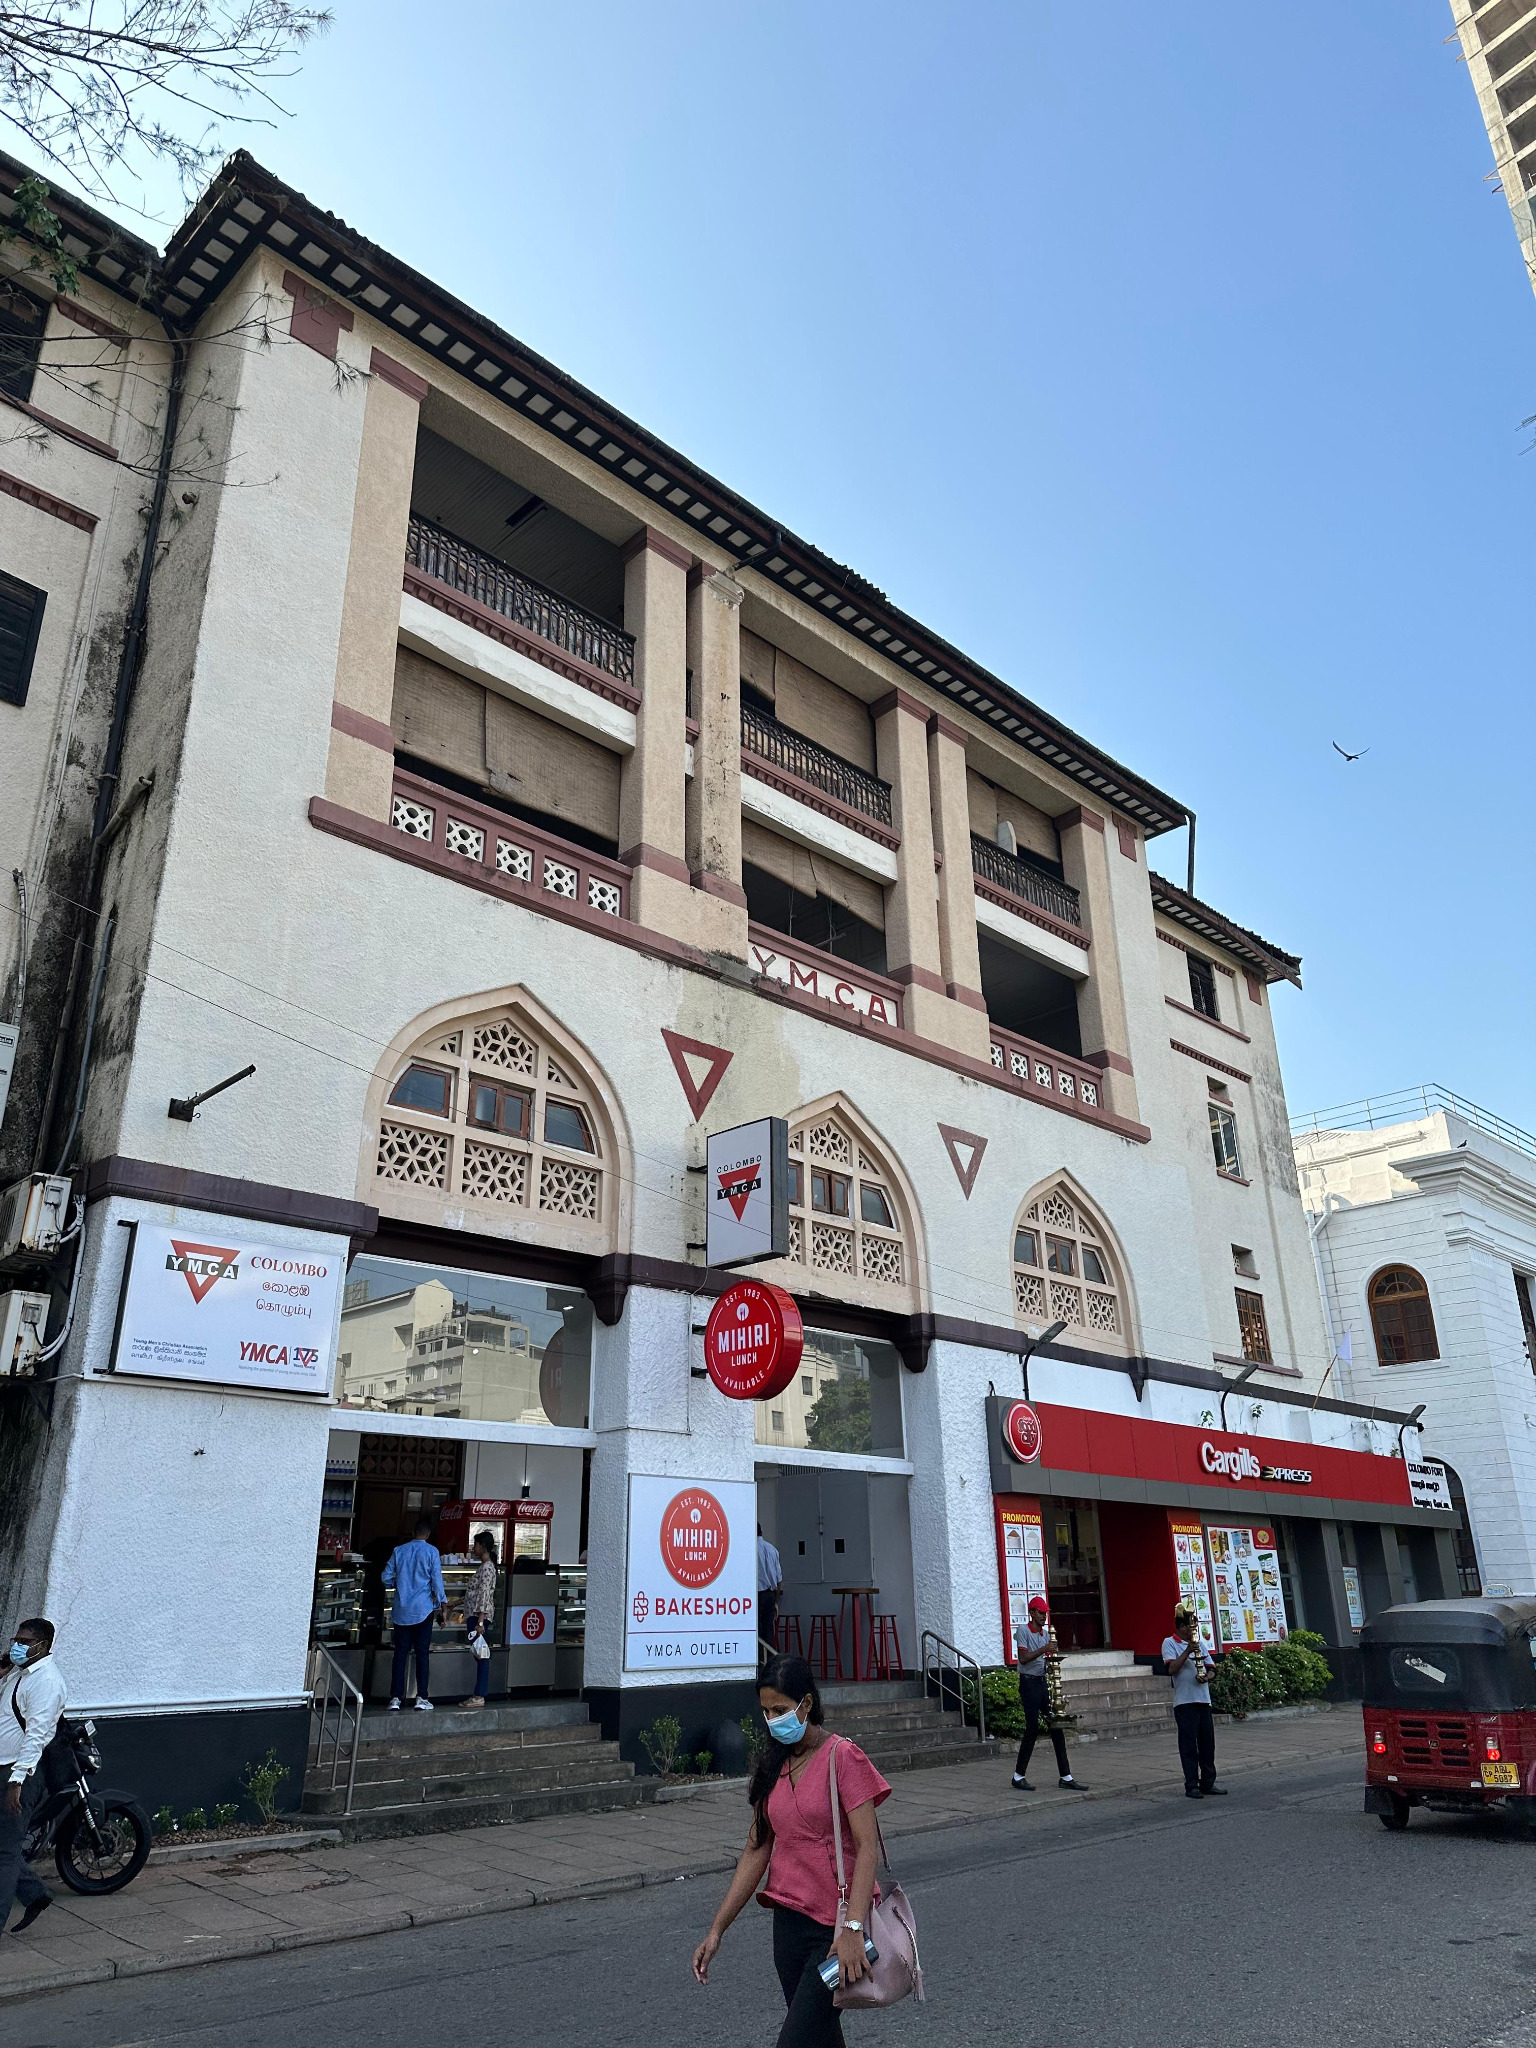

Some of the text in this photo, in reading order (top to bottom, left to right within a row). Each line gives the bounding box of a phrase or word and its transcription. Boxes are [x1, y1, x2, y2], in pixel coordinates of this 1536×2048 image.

[717, 1155, 761, 1173] COLOMBO
[720, 1180, 758, 1198] YMCA
[171, 1257, 235, 1278] YMCA
[251, 1256, 328, 1278] COLOMBO
[725, 1289, 760, 1306] EST. 1983
[256, 1298, 312, 1319] கொழும்பு
[718, 1322, 770, 1353] MIHIRI
[240, 1341, 288, 1365] YMCA
[731, 1352, 757, 1367] LUNCH
[724, 1370, 765, 1390] AVAILABLE
[1201, 1441, 1312, 1483] Cargills EXPRESS
[1408, 1463, 1431, 1475] COLOMBO
[472, 1500, 507, 1516] Coca-Cola
[517, 1501, 551, 1517] Coca-Cola
[680, 1497, 711, 1510] EST. 1983
[1002, 1512, 1041, 1524] PROMOTION
[1172, 1525, 1202, 1533] PROMOTION
[673, 1528, 718, 1548] MIHIRI
[684, 1551, 707, 1561] LUNCH
[677, 1567, 713, 1582] AVAILABLE
[655, 1598, 752, 1616] BAKESHOP
[646, 1642, 739, 1657] YMCA OUTLET
